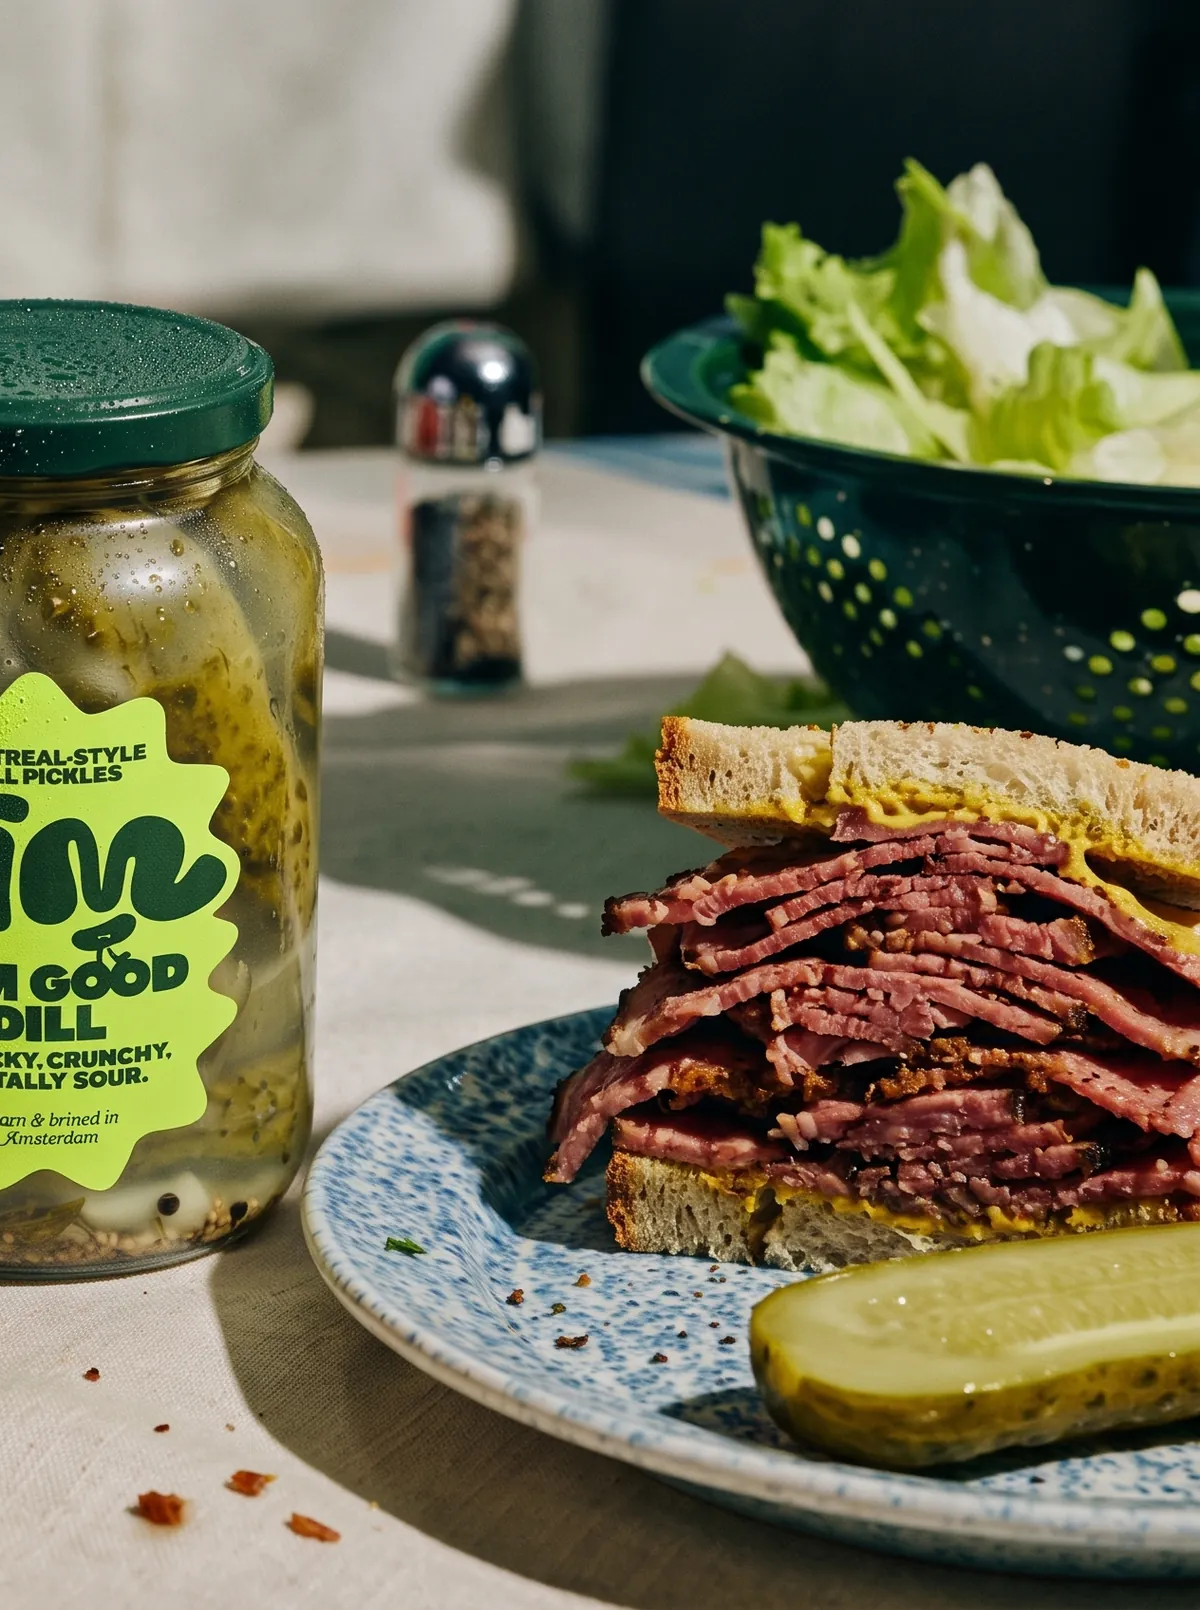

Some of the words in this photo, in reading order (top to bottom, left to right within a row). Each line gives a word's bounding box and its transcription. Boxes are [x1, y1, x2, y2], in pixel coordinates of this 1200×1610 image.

[22, 765, 123, 785] PICKLES
[29, 953, 189, 1002] GOOD
[46, 1041, 172, 1069] CRUNCHY,
[73, 1066, 149, 1089] SOUR.
[30, 1112, 46, 1128] &
[49, 1110, 101, 1127] brined
[104, 1109, 119, 1125] in
